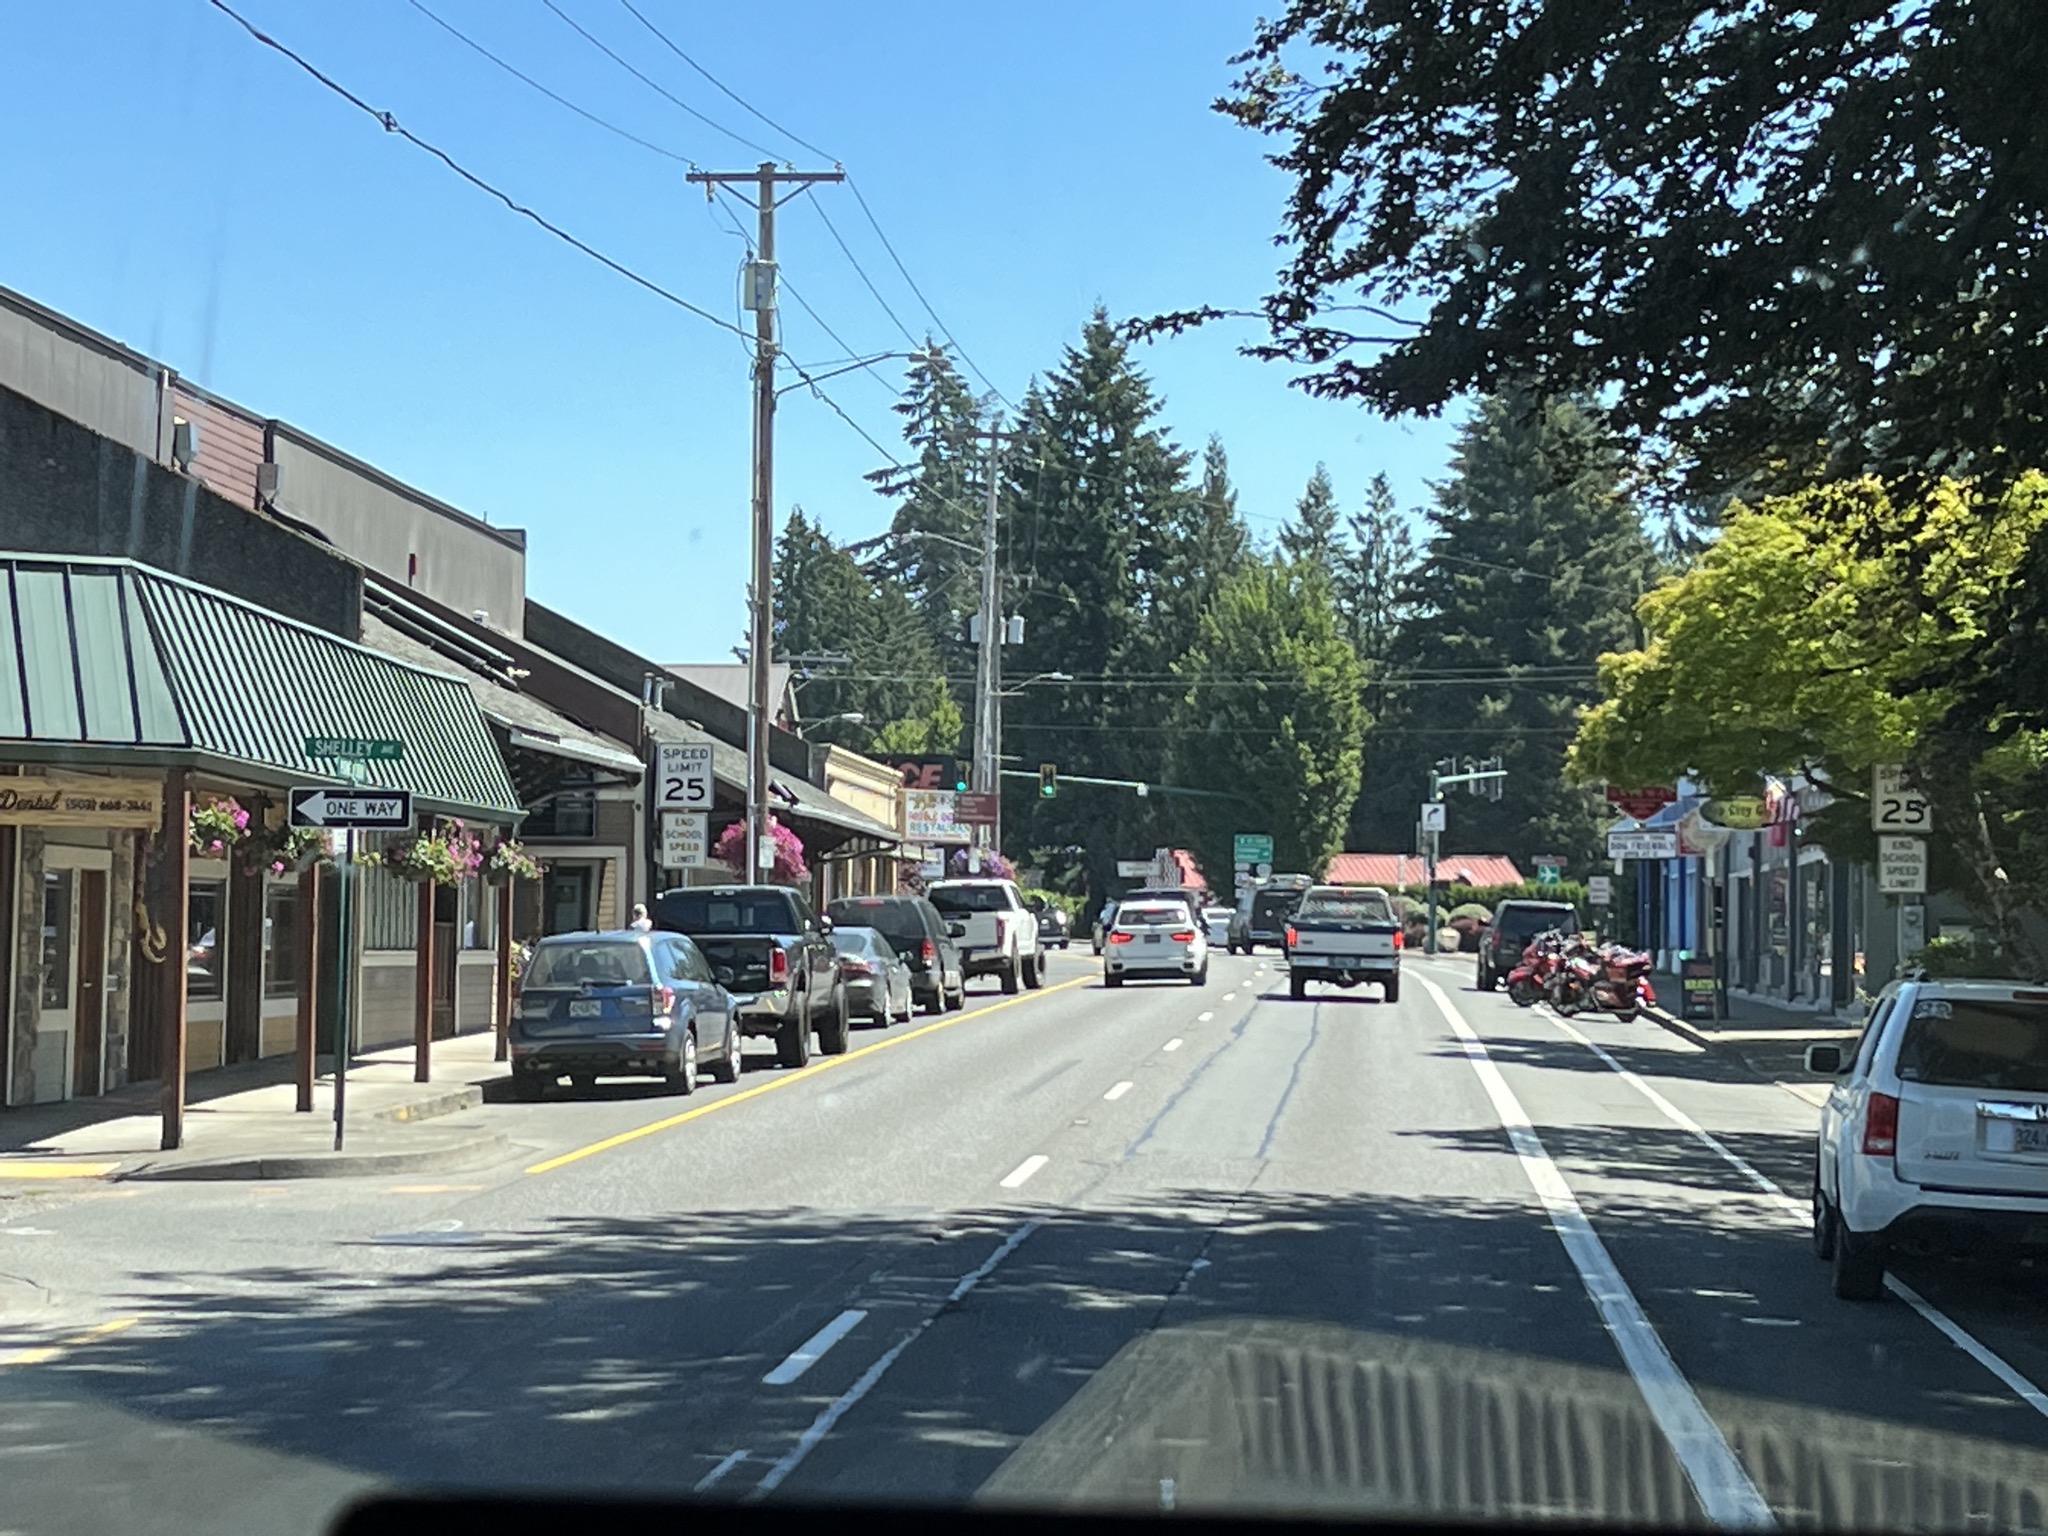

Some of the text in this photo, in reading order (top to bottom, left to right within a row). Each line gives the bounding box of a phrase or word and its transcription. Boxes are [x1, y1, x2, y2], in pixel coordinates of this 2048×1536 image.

[315, 740, 374, 757] SHELLEY
[663, 748, 709, 760] SPEED
[667, 763, 702, 773] LIMIT
[886, 760, 943, 789] CE
[665, 777, 705, 801] 25
[0, 788, 63, 811] Dental
[326, 801, 397, 816] ONE WAY
[1881, 799, 1925, 824] 25
[675, 817, 696, 827] END
[909, 823, 972, 833] RESTAURAN
[665, 829, 702, 840] SCHOOL
[669, 842, 700, 852] SPEED
[1892, 841, 1914, 850] END
[672, 854, 697, 864] LIMIT
[1882, 853, 1922, 863] SCHOOL
[1886, 866, 1919, 876] SPEED
[1889, 879, 1916, 888] LIMIT
